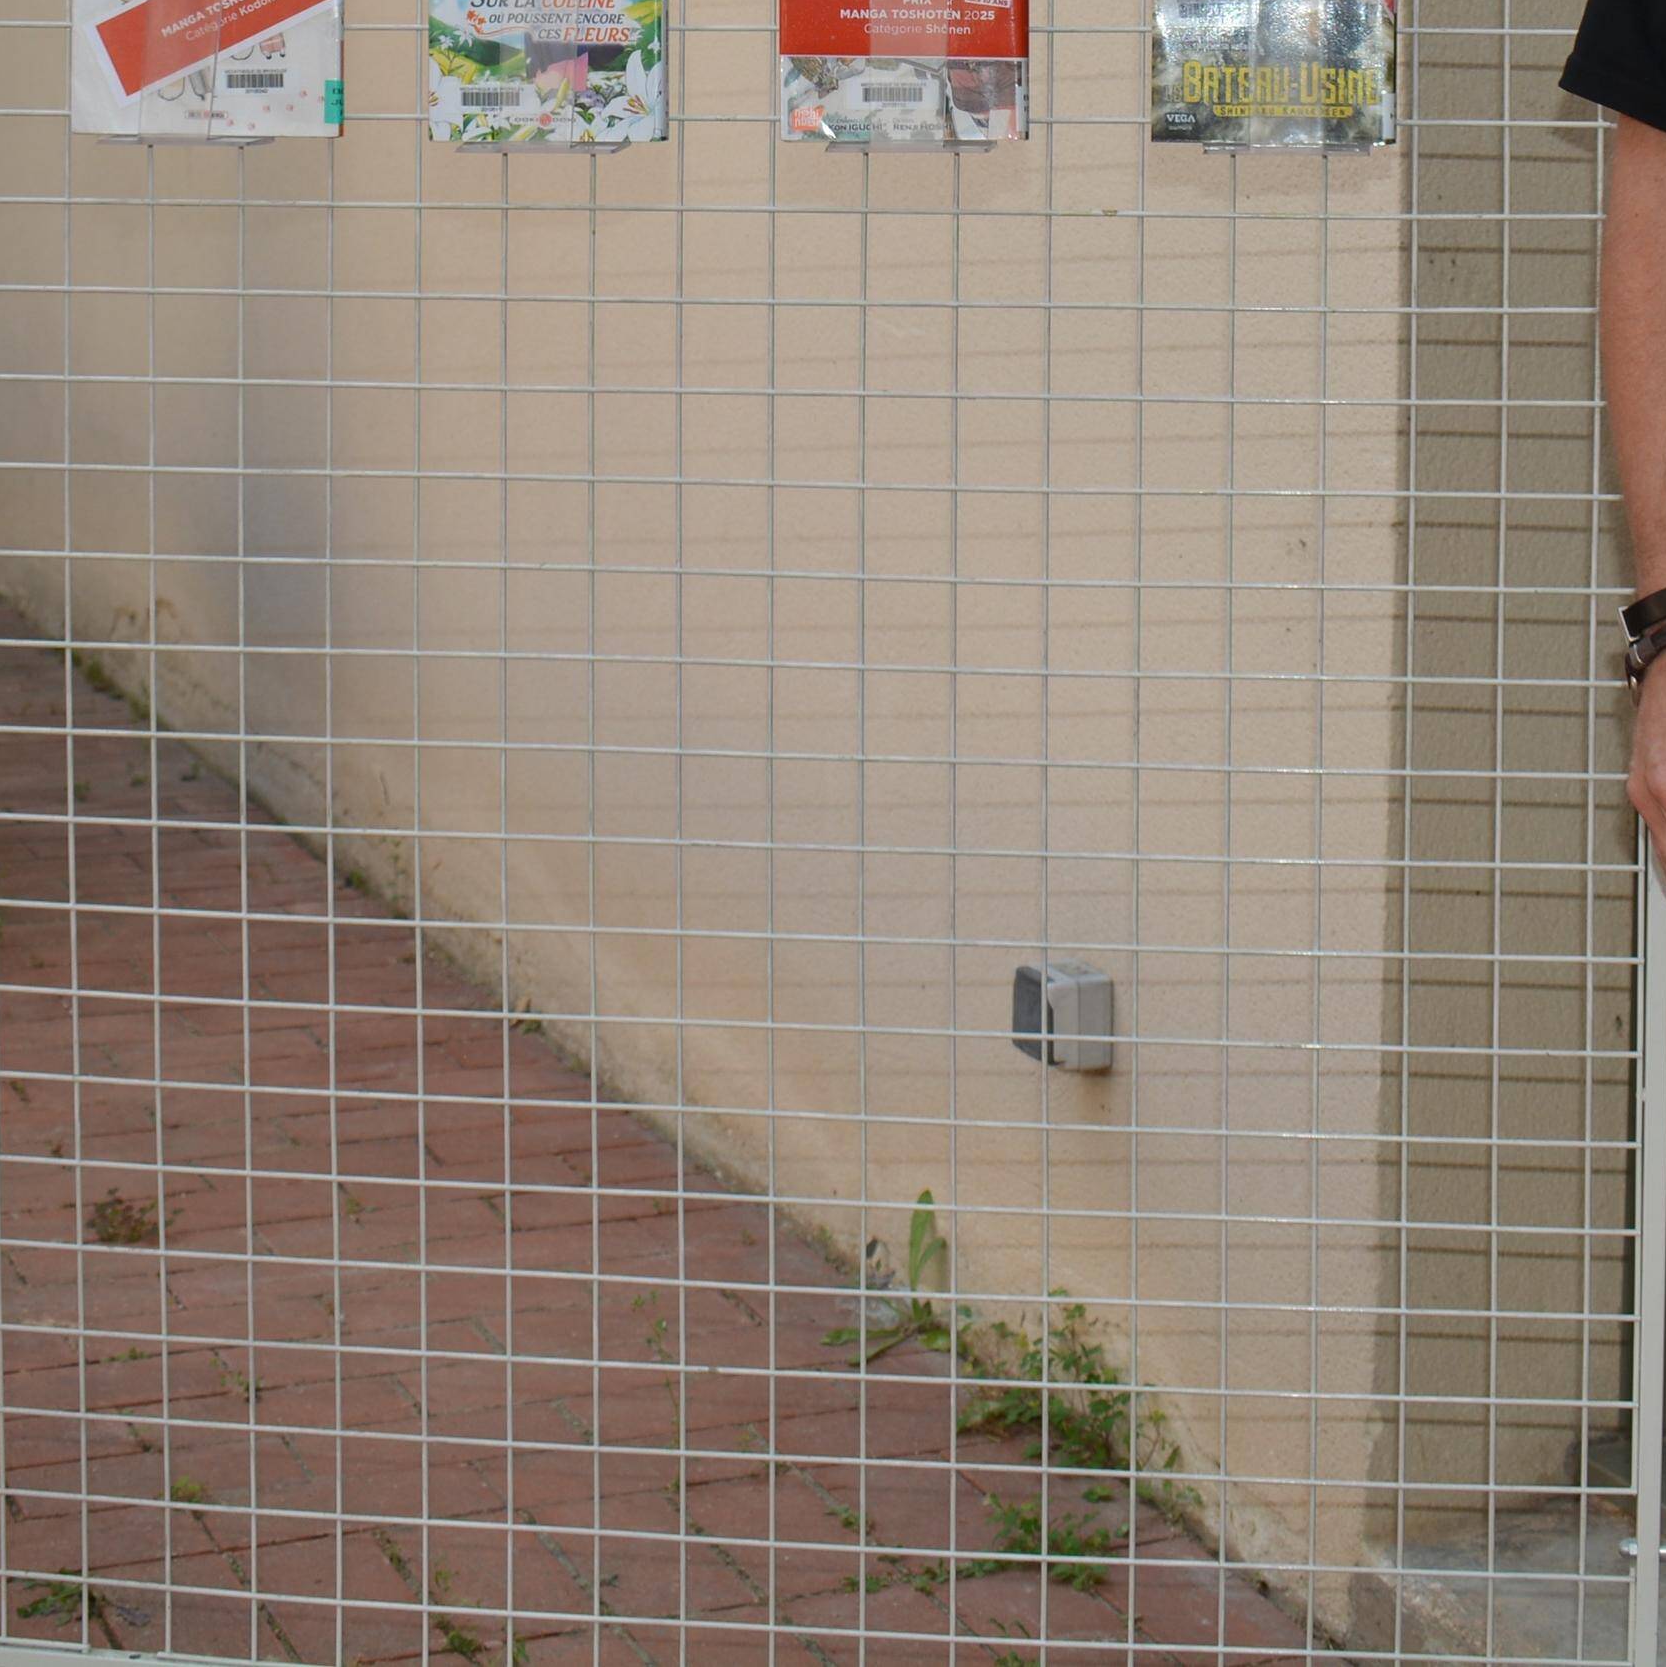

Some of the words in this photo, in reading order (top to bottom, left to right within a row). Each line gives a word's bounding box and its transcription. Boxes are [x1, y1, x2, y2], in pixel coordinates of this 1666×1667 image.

[507, 13, 572, 24] POUSSENT
[576, 13, 625, 24] ENCORE
[840, 9, 887, 19] MANGA
[892, 9, 961, 20] TOSHOTEN
[964, 10, 995, 21] 2025
[161, 11, 205, 38] MANGA
[537, 28, 561, 40] CES
[1166, 113, 1196, 123] VEGA
